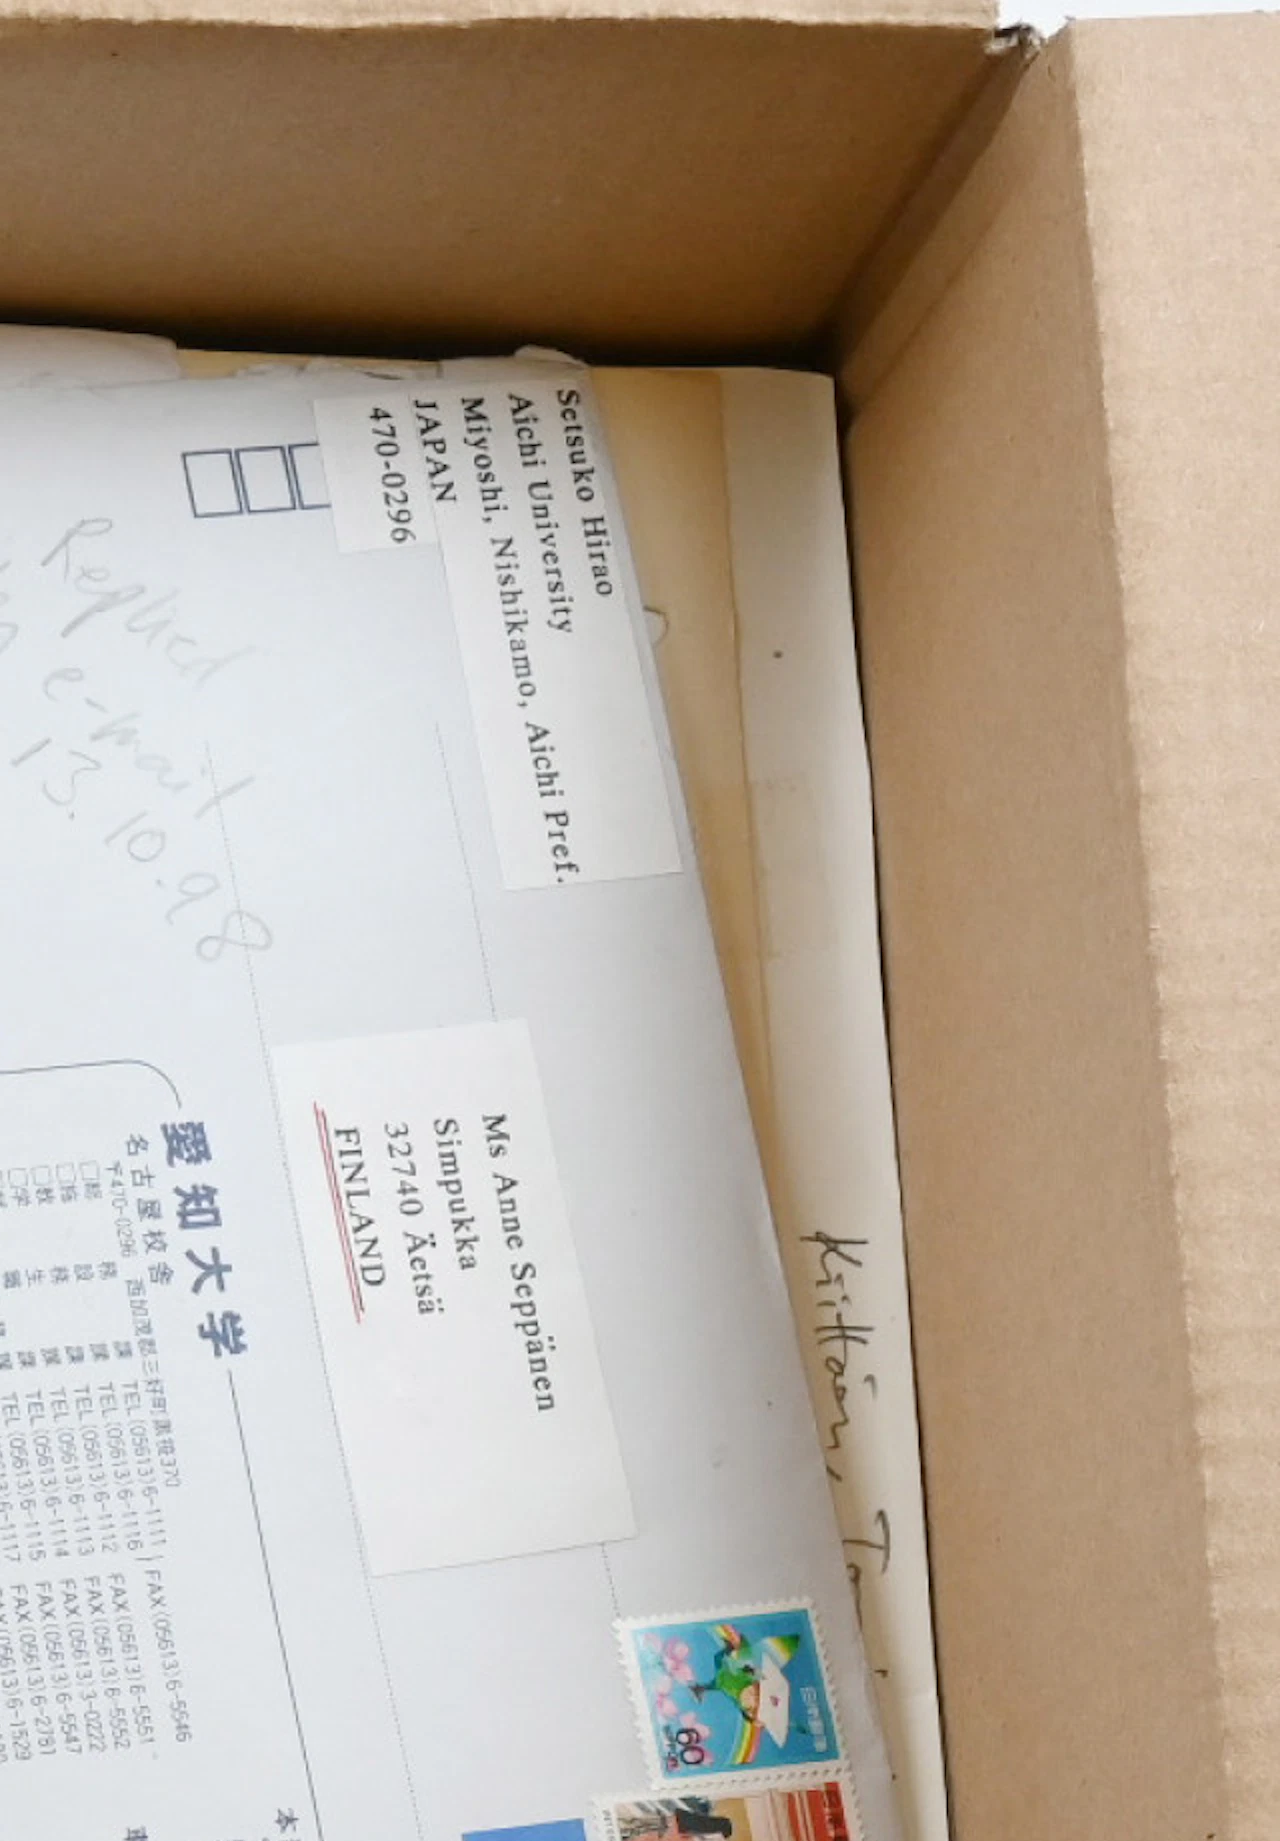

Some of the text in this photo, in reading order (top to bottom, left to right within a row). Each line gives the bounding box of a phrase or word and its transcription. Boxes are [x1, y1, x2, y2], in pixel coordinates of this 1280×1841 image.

[368, 405, 417, 545] 470-0296
[413, 398, 458, 504] JAPAN
[507, 391, 577, 634] Aichi University
[556, 389, 614, 598] Setsuko Hirao
[460, 396, 582, 885] Miyoshi, Nishikamo, Aichi Pref.
[124, 1132, 176, 1287] 名古屋校舎
[161, 1120, 249, 1359] 愛知大学
[333, 1126, 388, 1288] FINLAND
[384, 1122, 445, 1316] 32740 Äetsä
[432, 1117, 480, 1272] Simpukka
[481, 1113, 558, 1413] Ms Anne Seppänen
[676, 1728, 705, 1765] 60
